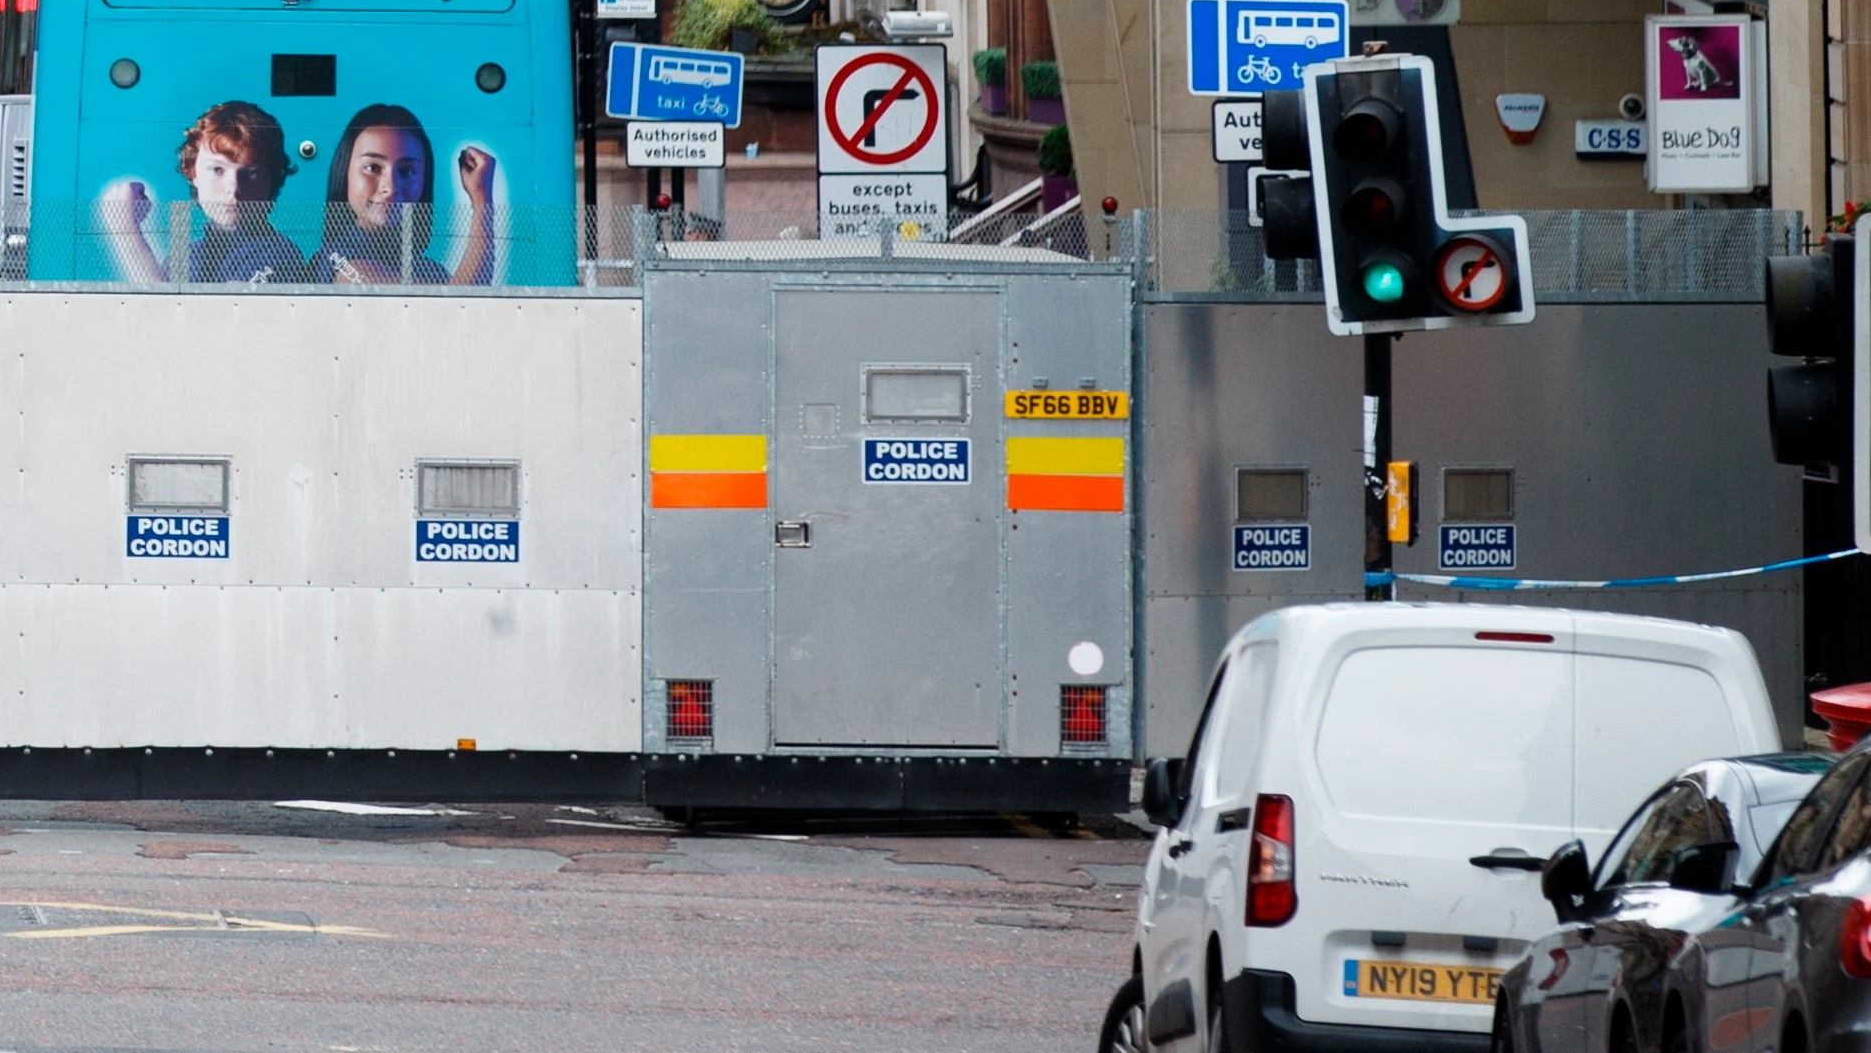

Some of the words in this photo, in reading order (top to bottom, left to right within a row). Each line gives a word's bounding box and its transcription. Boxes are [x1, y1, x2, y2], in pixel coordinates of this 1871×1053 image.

[657, 94, 686, 111] taxi
[633, 127, 717, 143] Authorised
[644, 144, 707, 159] vehicles
[852, 181, 913, 198] except
[895, 200, 938, 215] taxis
[1015, 395, 1071, 415] SF66
[1077, 395, 1118, 415] BBV
[876, 442, 958, 459] POLICE
[869, 463, 965, 480] CORDON
[138, 518, 219, 535] POLICE
[427, 522, 509, 540] POLICE
[1242, 529, 1301, 545] POLICE
[1448, 529, 1507, 545] POLICE
[130, 539, 226, 556] CORDON
[420, 543, 516, 560] CORDON
[1237, 549, 1306, 566] CORDON
[1443, 549, 1512, 565] CORDON
[1369, 966, 1437, 996] NY19
